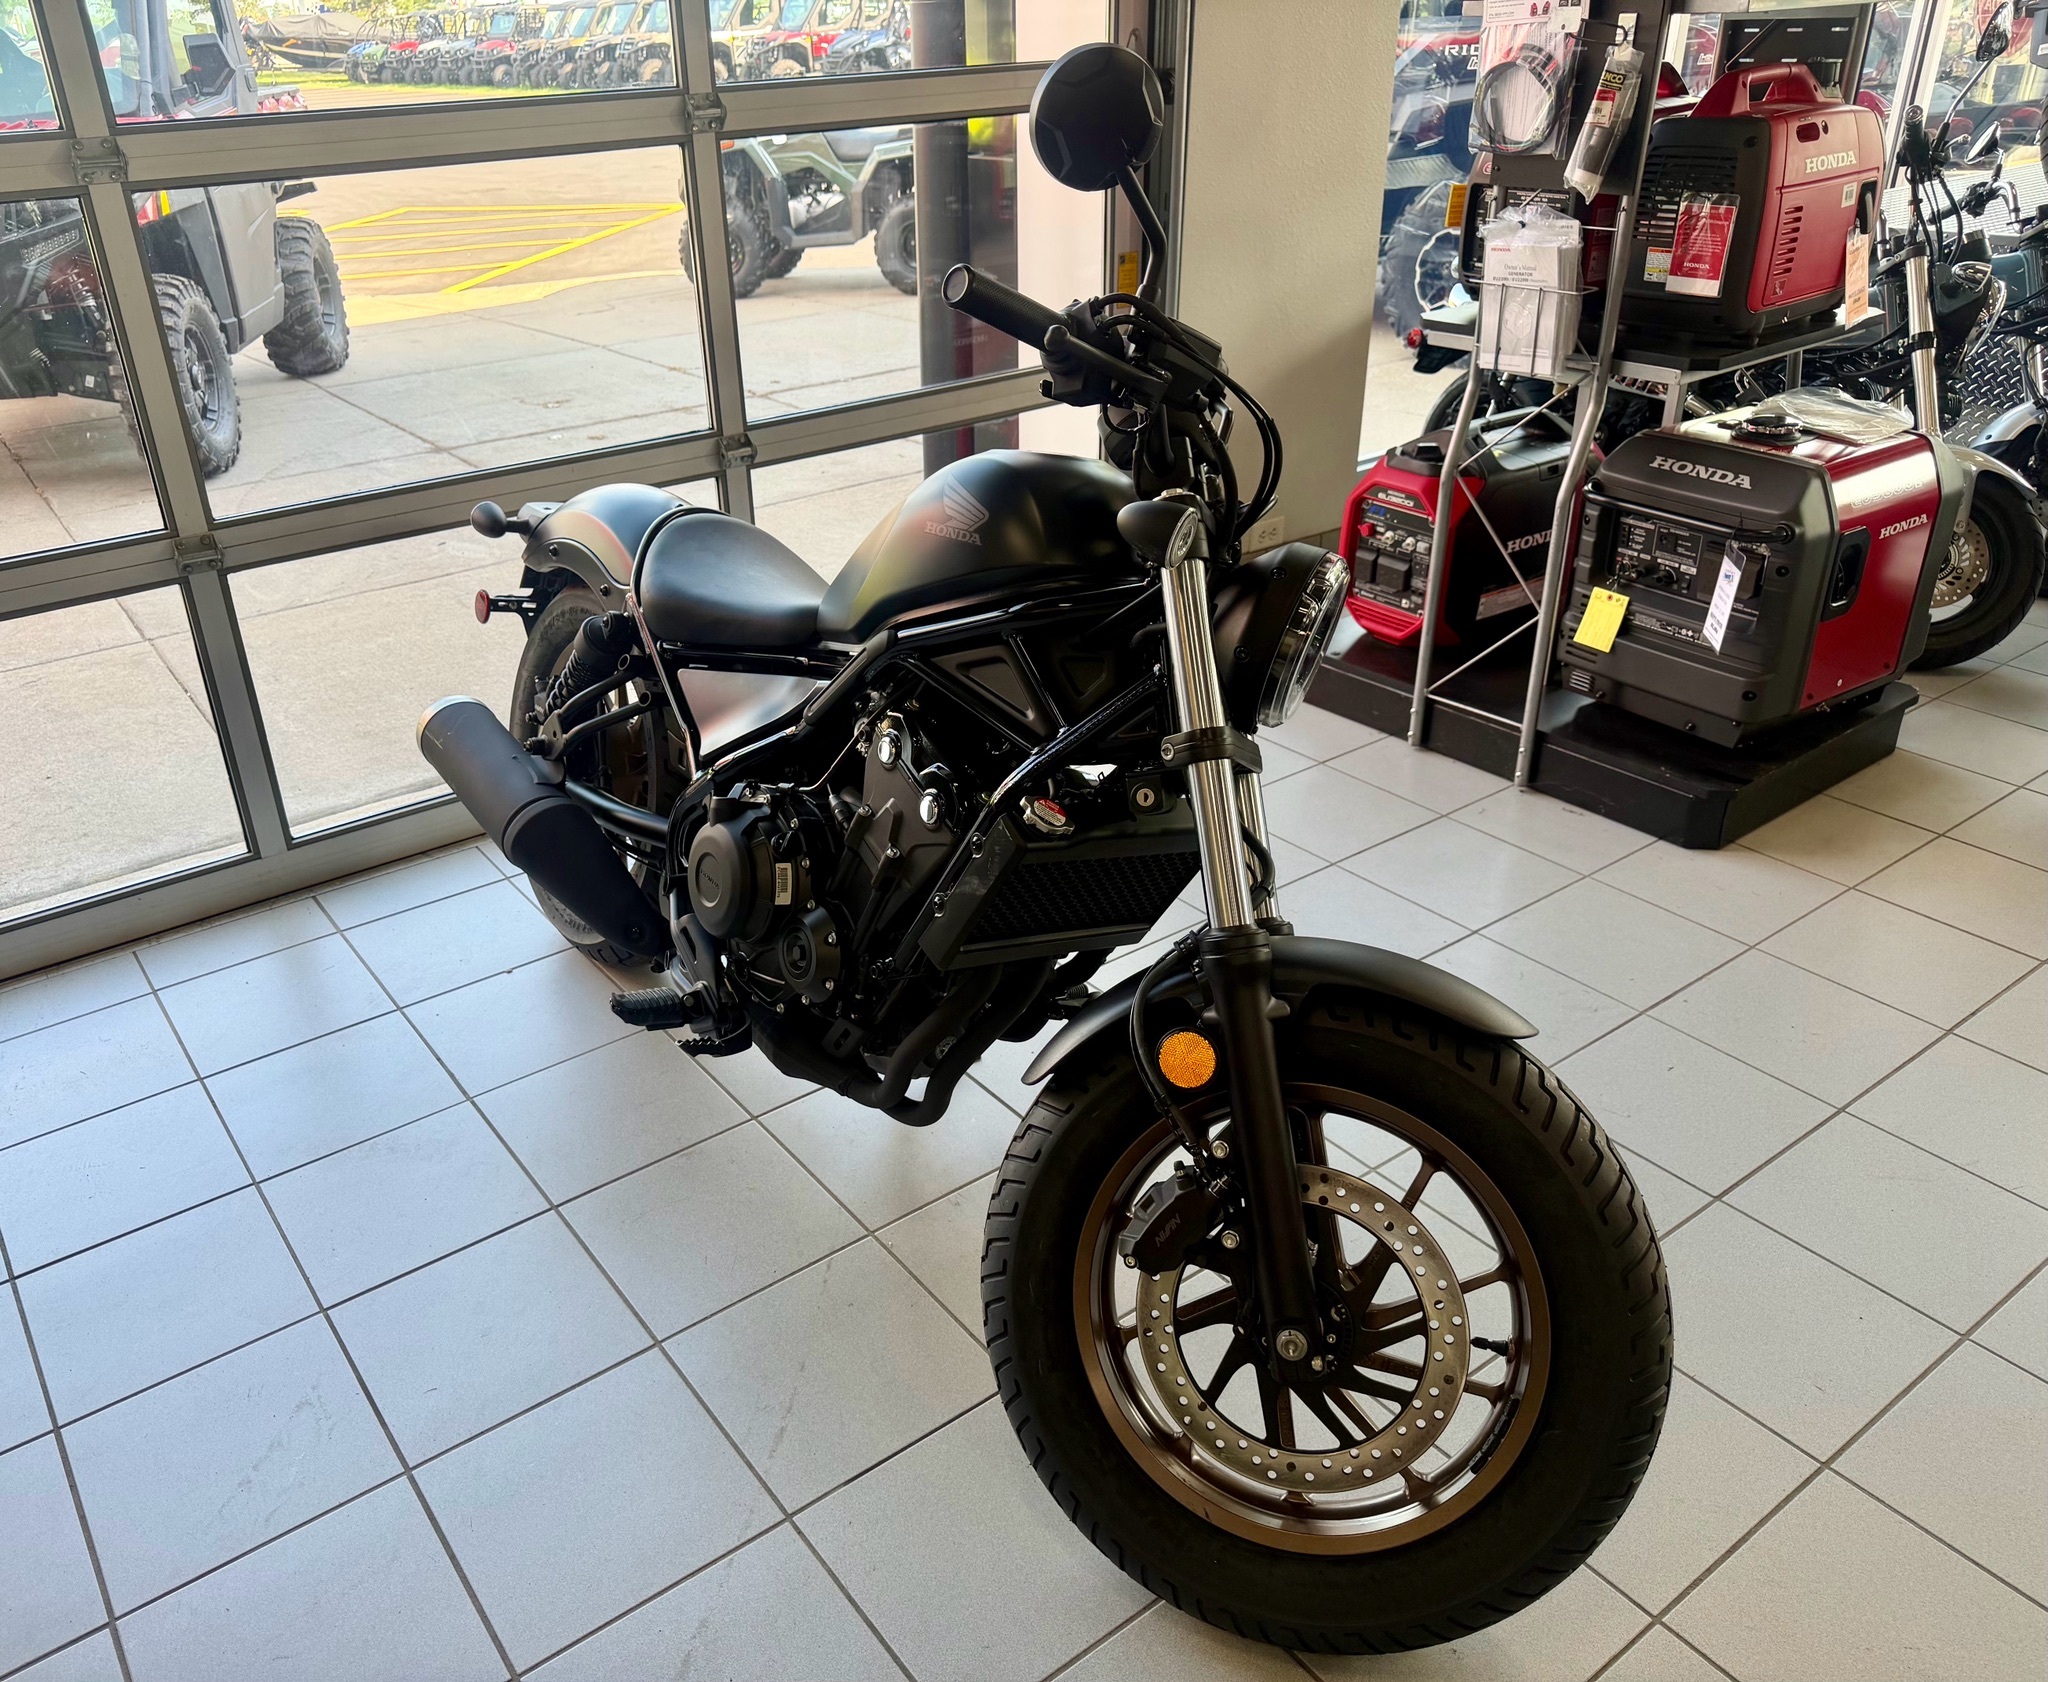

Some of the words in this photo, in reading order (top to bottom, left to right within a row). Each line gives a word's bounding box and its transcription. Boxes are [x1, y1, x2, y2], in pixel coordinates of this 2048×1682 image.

[1805, 151, 1857, 174] HONDA
[1683, 261, 1710, 270] HONDA
[1649, 455, 1752, 490] HONDA
[924, 520, 982, 546] HONDA
[1879, 513, 1928, 540] HONDA
[1507, 529, 1553, 554] HON
